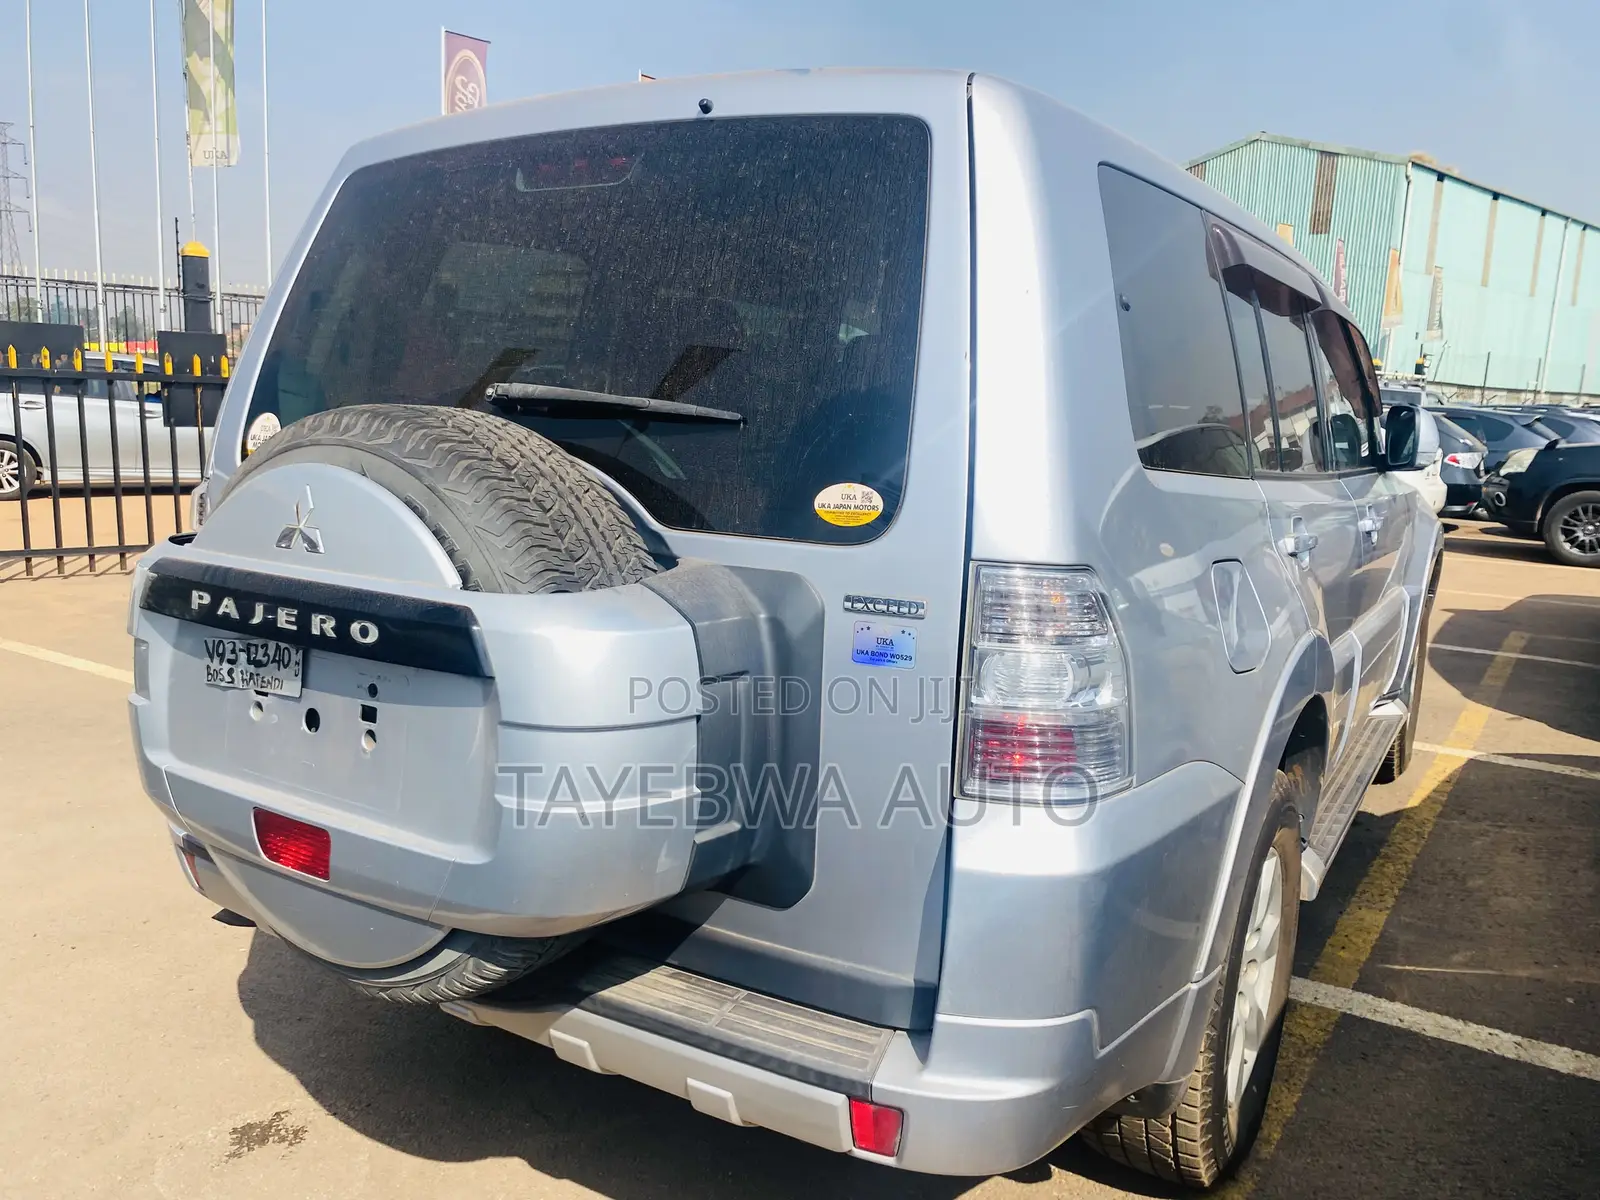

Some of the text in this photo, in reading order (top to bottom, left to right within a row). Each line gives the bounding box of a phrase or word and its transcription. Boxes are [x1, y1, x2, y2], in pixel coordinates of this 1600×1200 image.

[850, 596, 919, 615] EXCEED
[191, 590, 379, 644] PAJERO
[876, 637, 894, 647] UKA
[871, 650, 889, 659] BOND
[206, 664, 235, 684] BOSS
